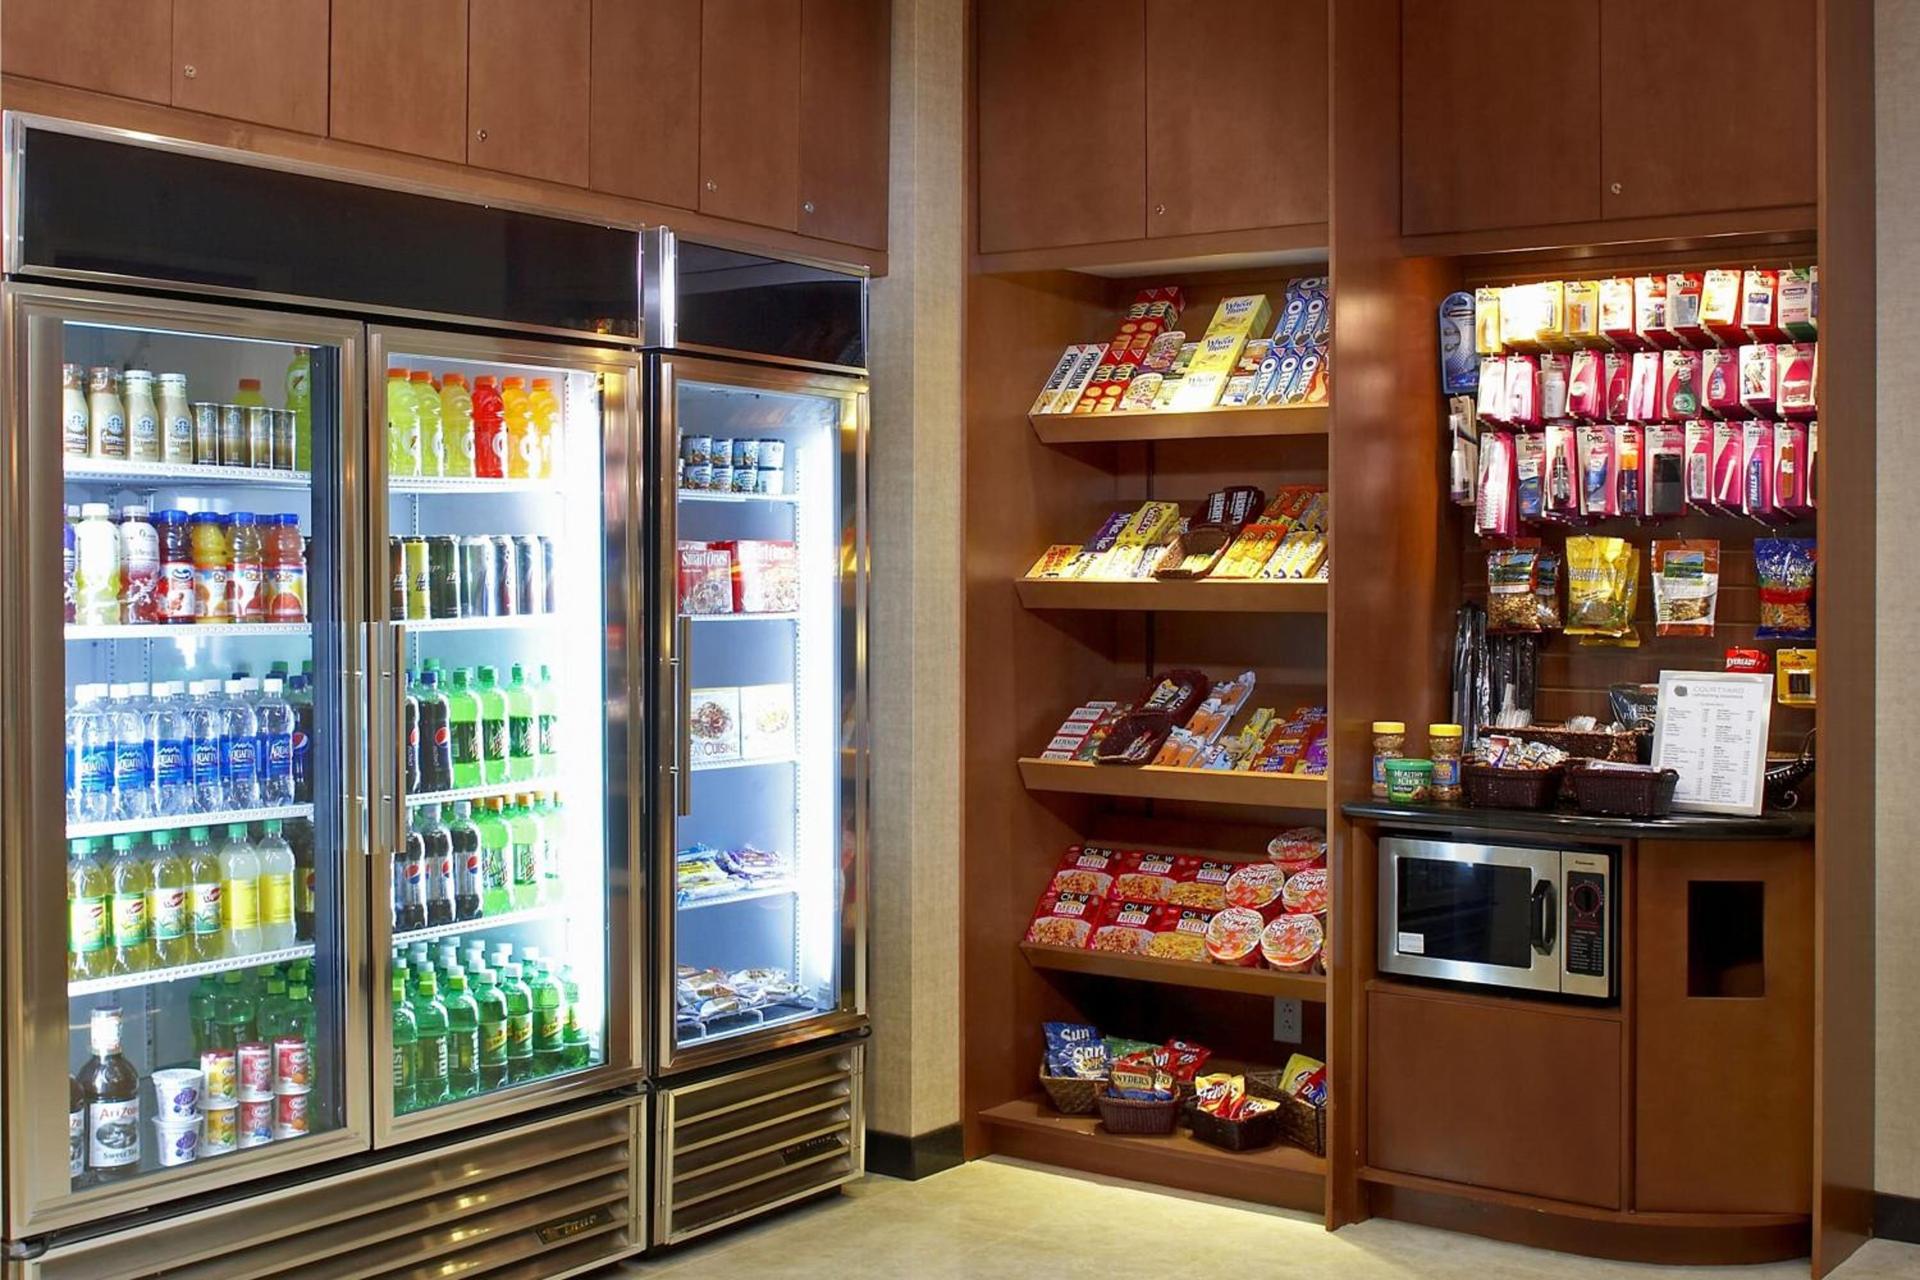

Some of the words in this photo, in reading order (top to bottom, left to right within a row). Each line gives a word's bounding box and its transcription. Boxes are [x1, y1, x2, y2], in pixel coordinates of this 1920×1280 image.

[1750, 463, 1760, 502] HALLS
[1078, 857, 1108, 868] MEIN
[1139, 862, 1171, 873] MEIN
[1197, 870, 1229, 881] MEIN
[1294, 874, 1327, 884] Soupe
[1053, 902, 1086, 915] MEIN
[1117, 912, 1150, 924] MEIN
[1059, 1028, 1090, 1043] Sun
[436, 1036, 448, 1076] mist
[393, 1047, 402, 1087] mist
